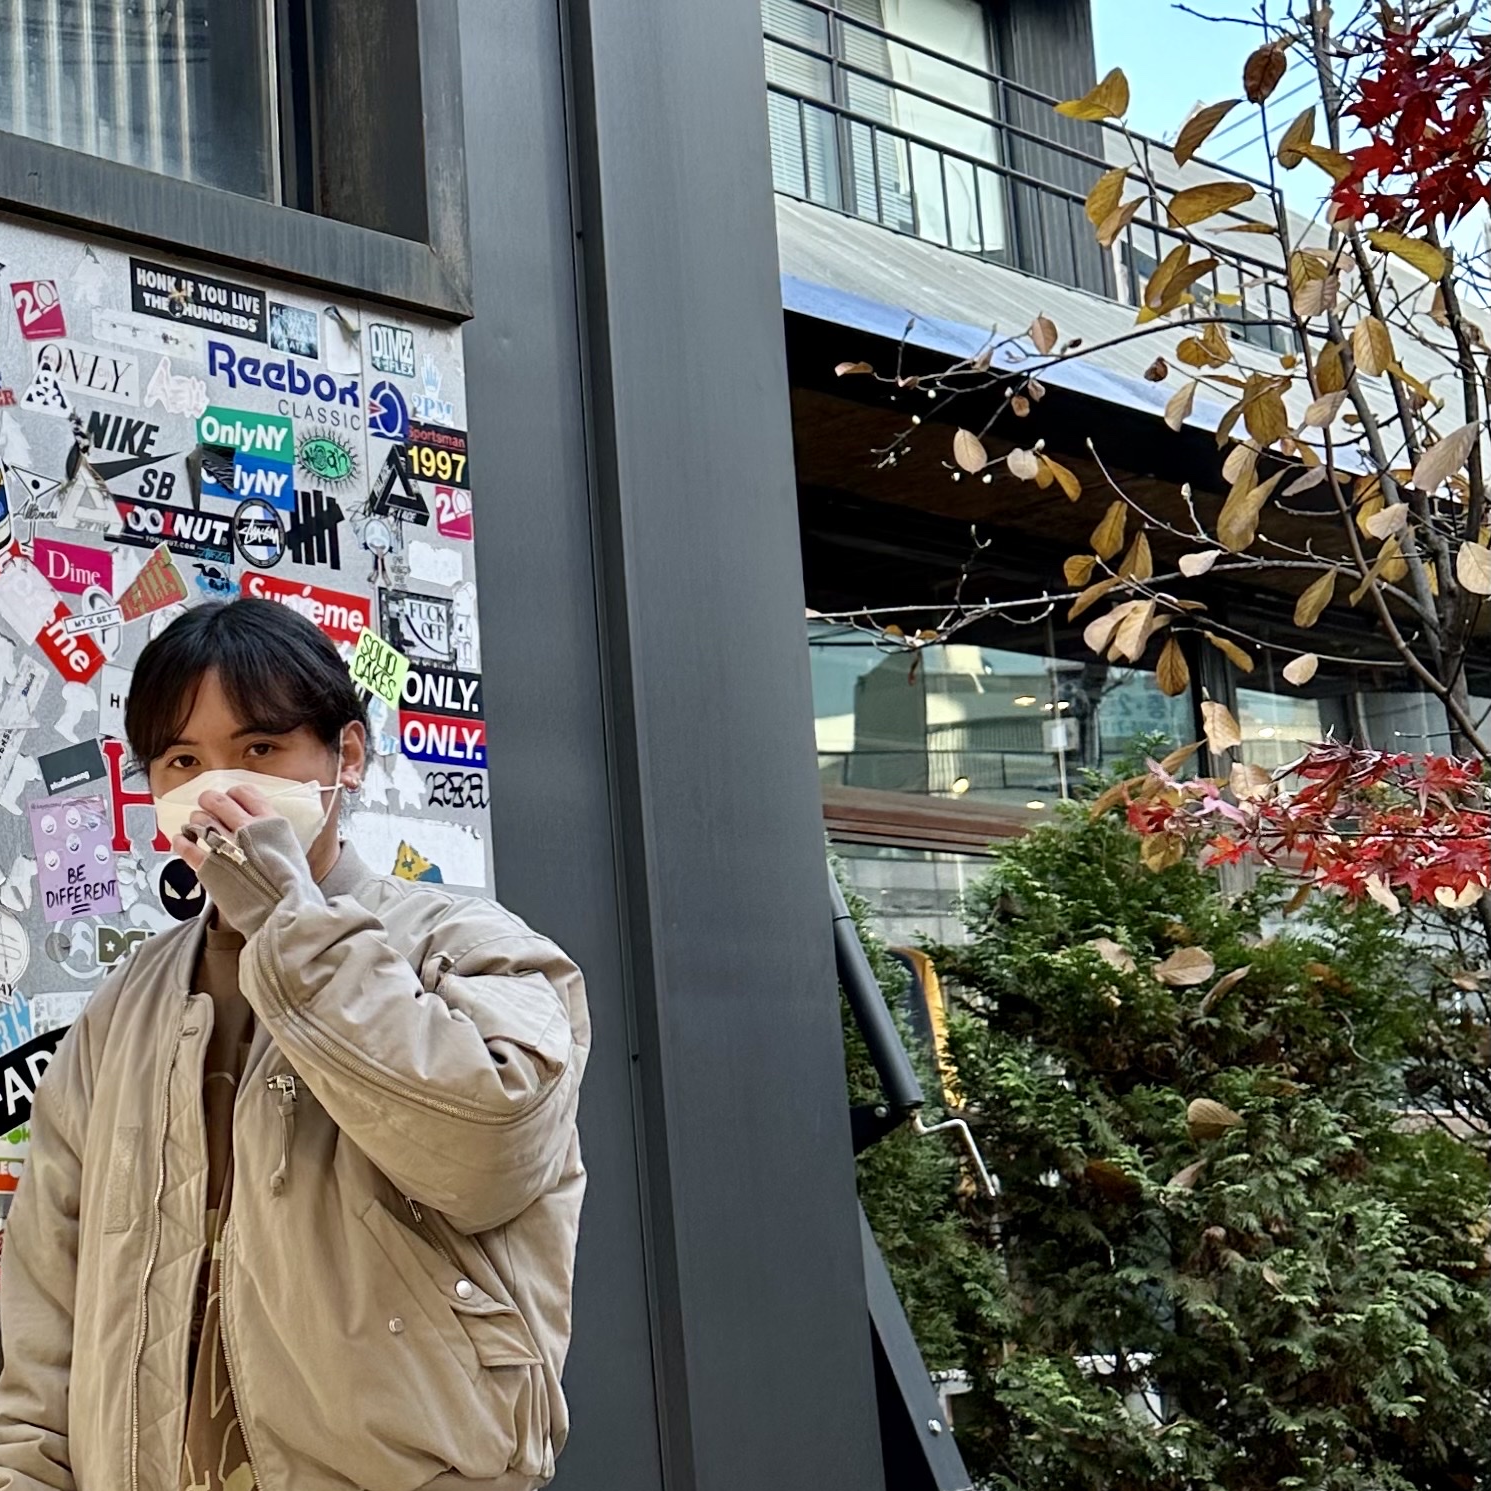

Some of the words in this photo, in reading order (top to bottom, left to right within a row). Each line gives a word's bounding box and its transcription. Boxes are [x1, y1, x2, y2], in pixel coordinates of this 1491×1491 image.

[136, 267, 180, 293] HONK
[198, 283, 228, 306] YOU
[231, 291, 261, 315] LIVE
[142, 294, 169, 311] THE
[181, 304, 258, 333] HUNDREDS
[278, 399, 361, 430] CLASSIC
[86, 410, 160, 457] NIKE
[201, 415, 288, 452] OnlyNY
[409, 446, 466, 483] 1997
[138, 469, 177, 501] SB
[48, 551, 101, 585] Dime
[410, 603, 445, 622] FUCK
[421, 622, 445, 641] OFF
[361, 633, 397, 677] SOLID
[354, 654, 396, 702] CAKES
[402, 670, 479, 712] ONLY.
[403, 720, 483, 761] ONLY.
[68, 865, 86, 885] BE
[46, 880, 117, 909] DIFFERENT
